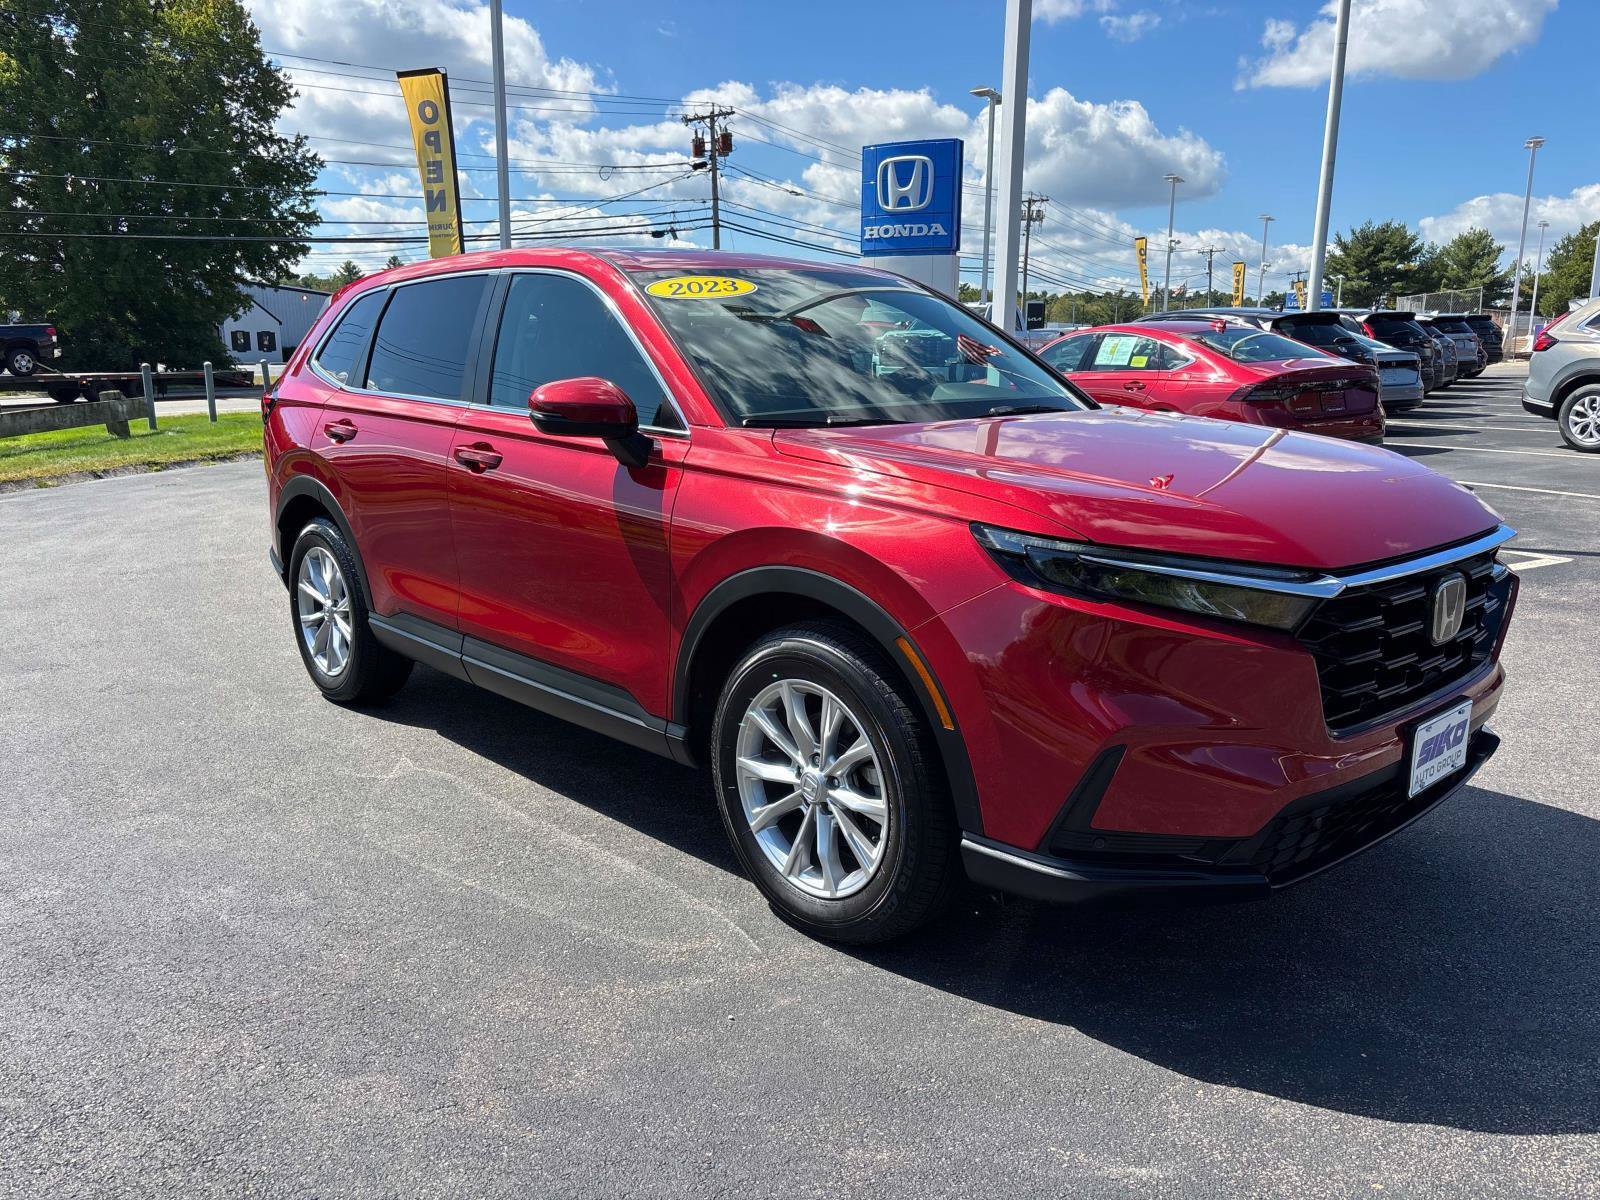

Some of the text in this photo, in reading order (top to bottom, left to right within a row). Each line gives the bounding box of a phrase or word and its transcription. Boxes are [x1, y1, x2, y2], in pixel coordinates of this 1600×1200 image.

[864, 223, 948, 240] HONDA
[668, 280, 739, 296] 2023
[1415, 750, 1462, 785] AUTO GROUP
